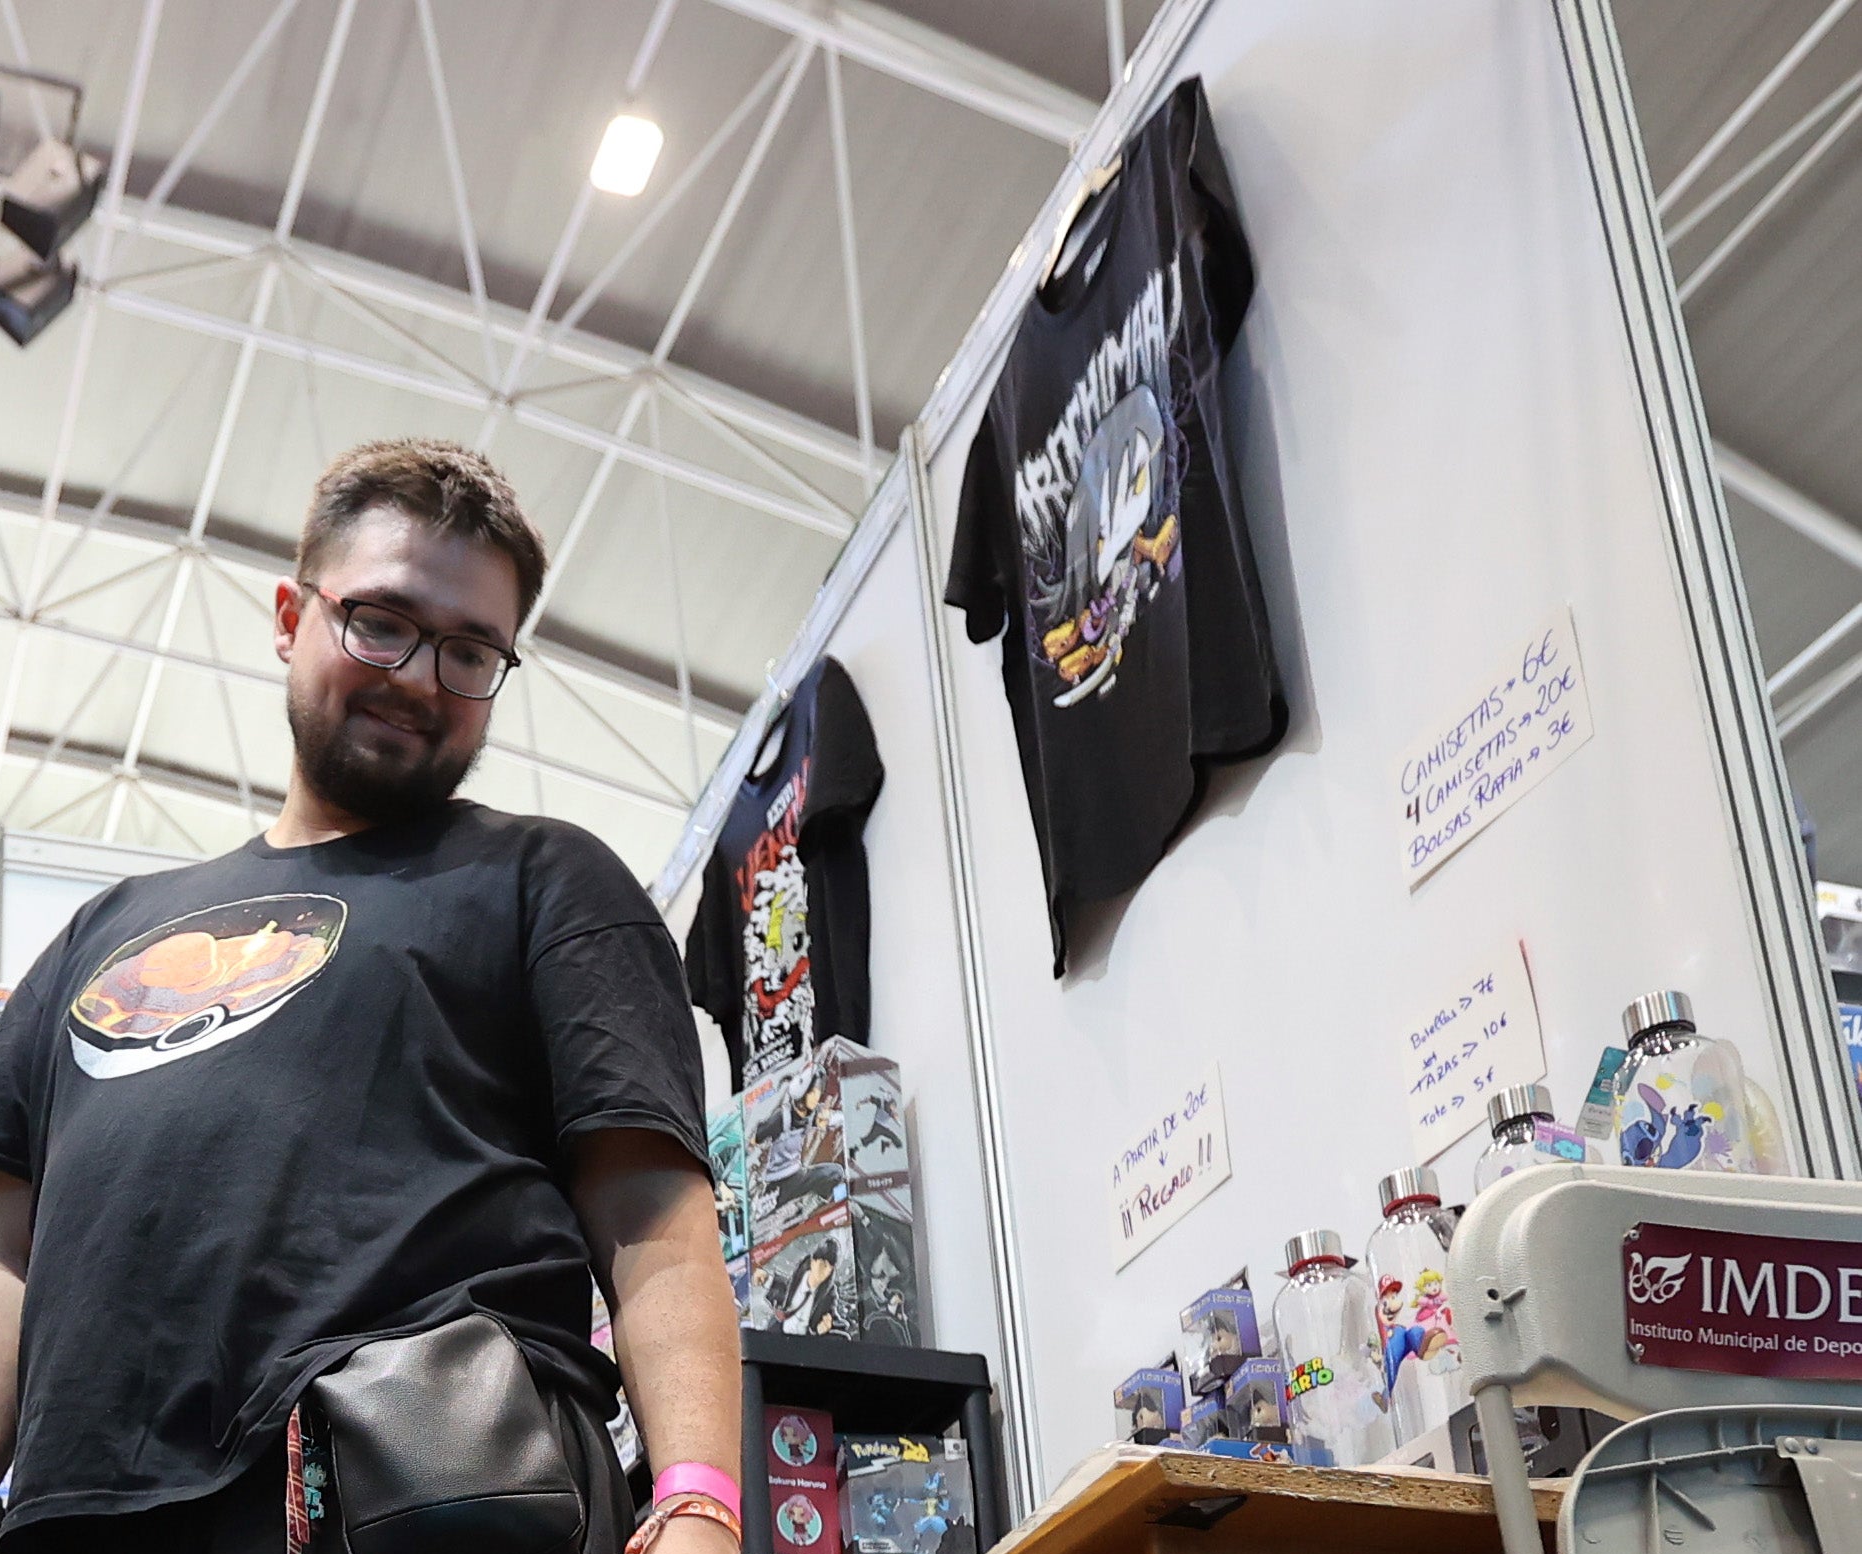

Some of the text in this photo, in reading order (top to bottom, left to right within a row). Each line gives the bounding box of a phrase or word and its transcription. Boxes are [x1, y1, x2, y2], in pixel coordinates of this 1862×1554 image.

[1523, 628, 1558, 683] 6€
[1406, 665, 1576, 826] 4 CAMISETAS 20€
[1546, 711, 1575, 750] 3€
[1113, 1165, 1121, 1188] A
[1630, 1318, 1693, 1343] Instituto
[1698, 1327, 1779, 1353] Municipal
[1784, 1334, 1807, 1352] de
